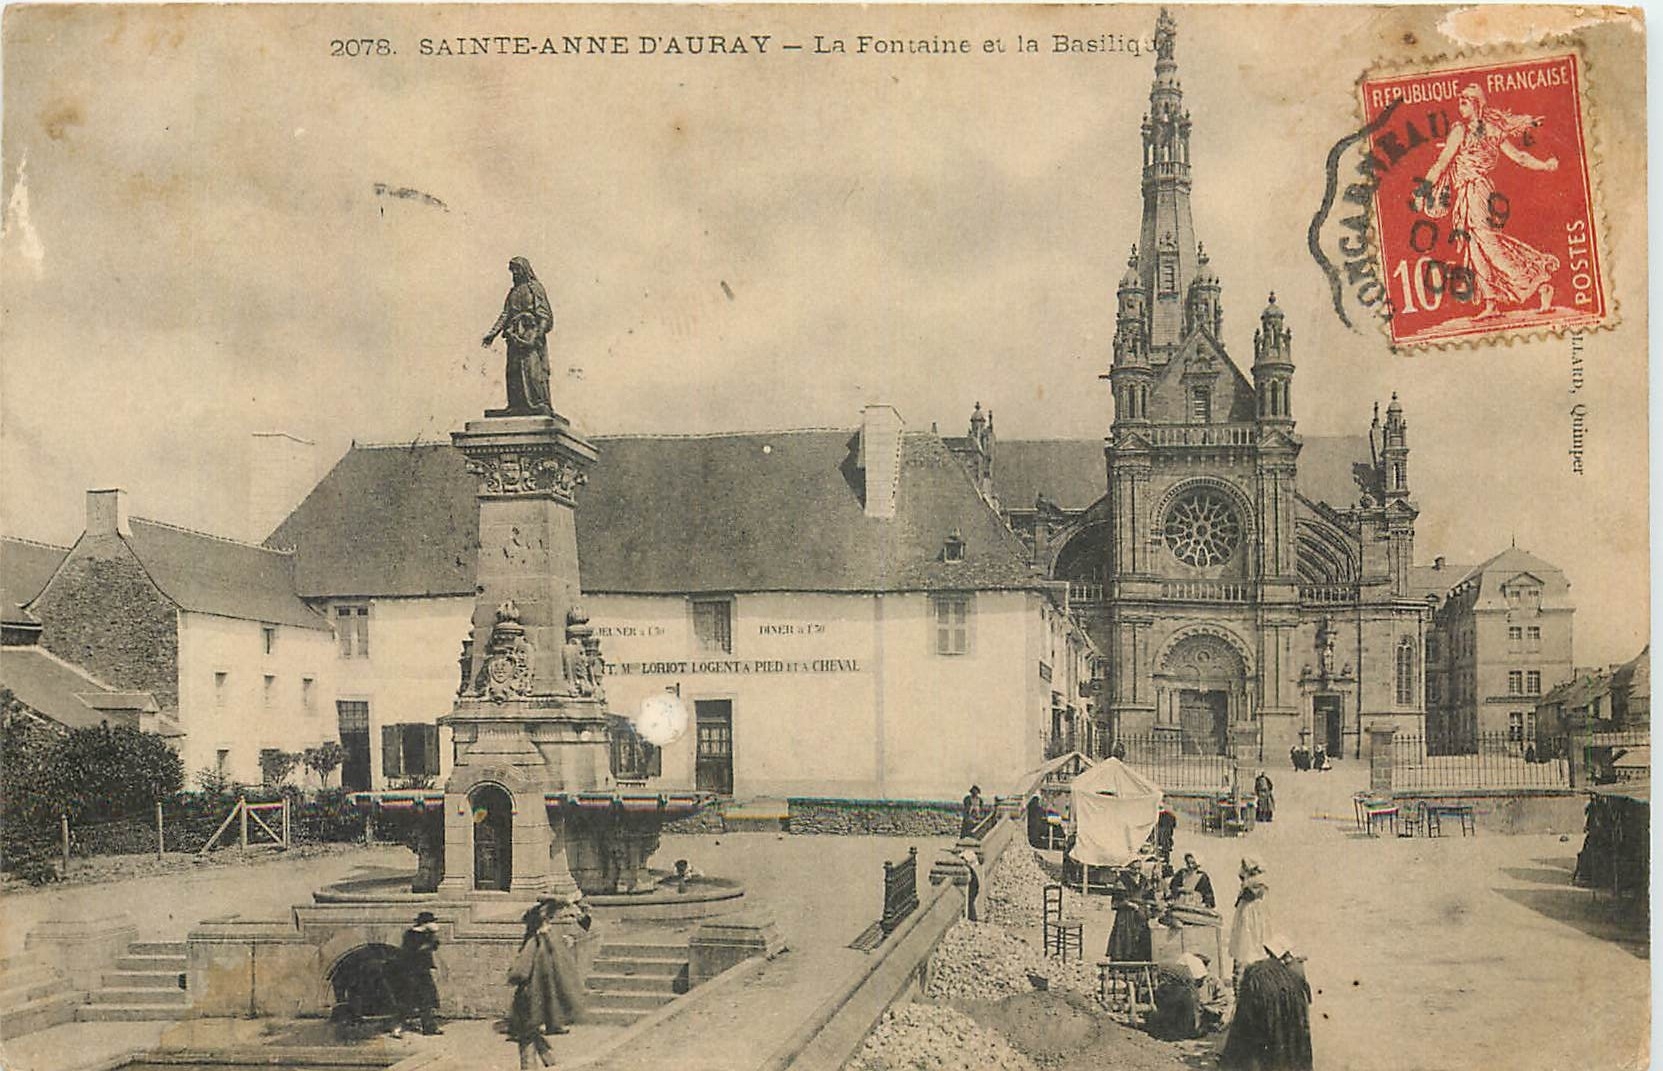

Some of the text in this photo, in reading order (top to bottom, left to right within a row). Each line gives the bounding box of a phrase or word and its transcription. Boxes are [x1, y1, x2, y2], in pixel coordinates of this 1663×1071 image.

[1487, 66, 1569, 94] FRANÇAISE
[1566, 219, 1593, 306] POSTES
[1393, 257, 1443, 315] 10
[641, 661, 688, 675] LORIOT
[755, 660, 784, 673] PIED
[812, 658, 861, 673] CHEVAL
